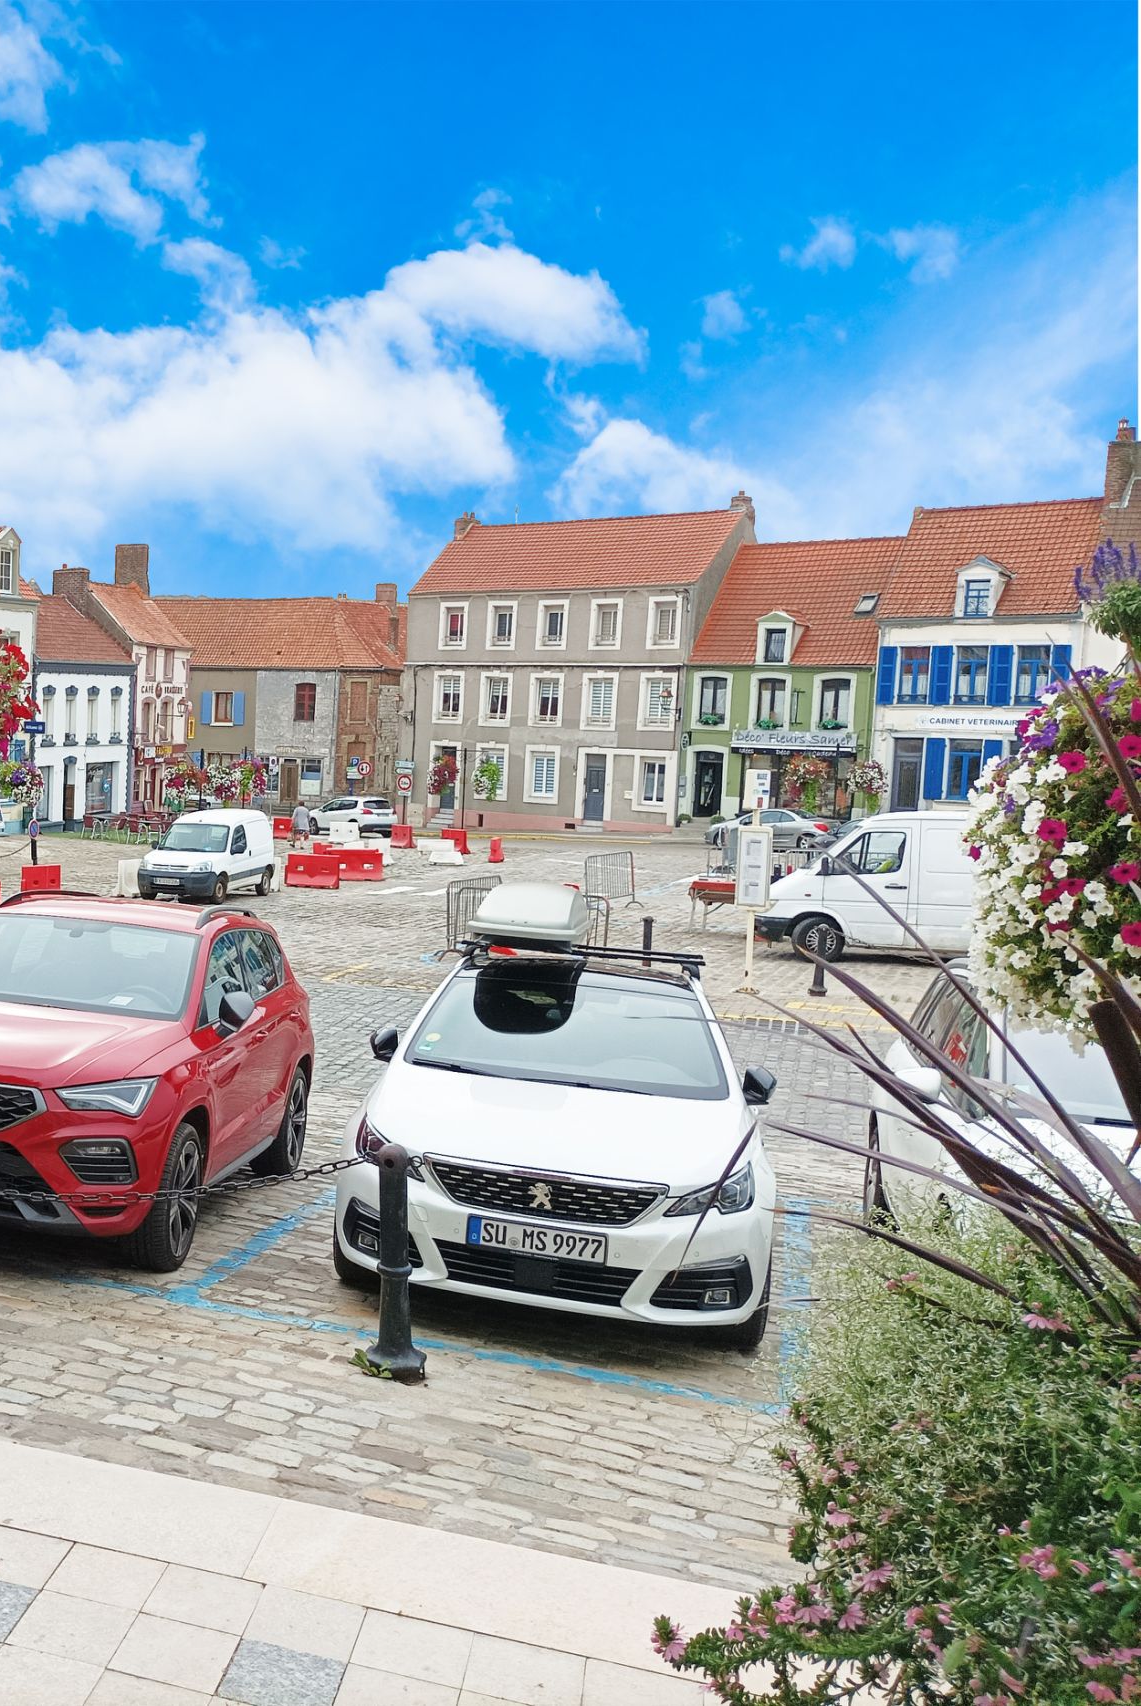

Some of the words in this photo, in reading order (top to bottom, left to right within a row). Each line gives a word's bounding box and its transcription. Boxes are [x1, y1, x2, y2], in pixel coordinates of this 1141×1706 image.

[929, 717, 966, 725] CABINET
[967, 718, 1018, 726] VETERINAIR
[768, 733, 806, 744] Fleurs
[809, 735, 852, 746] Samer
[482, 1222, 508, 1246] SU
[521, 1228, 548, 1252] MS
[552, 1233, 603, 1259] 9977
